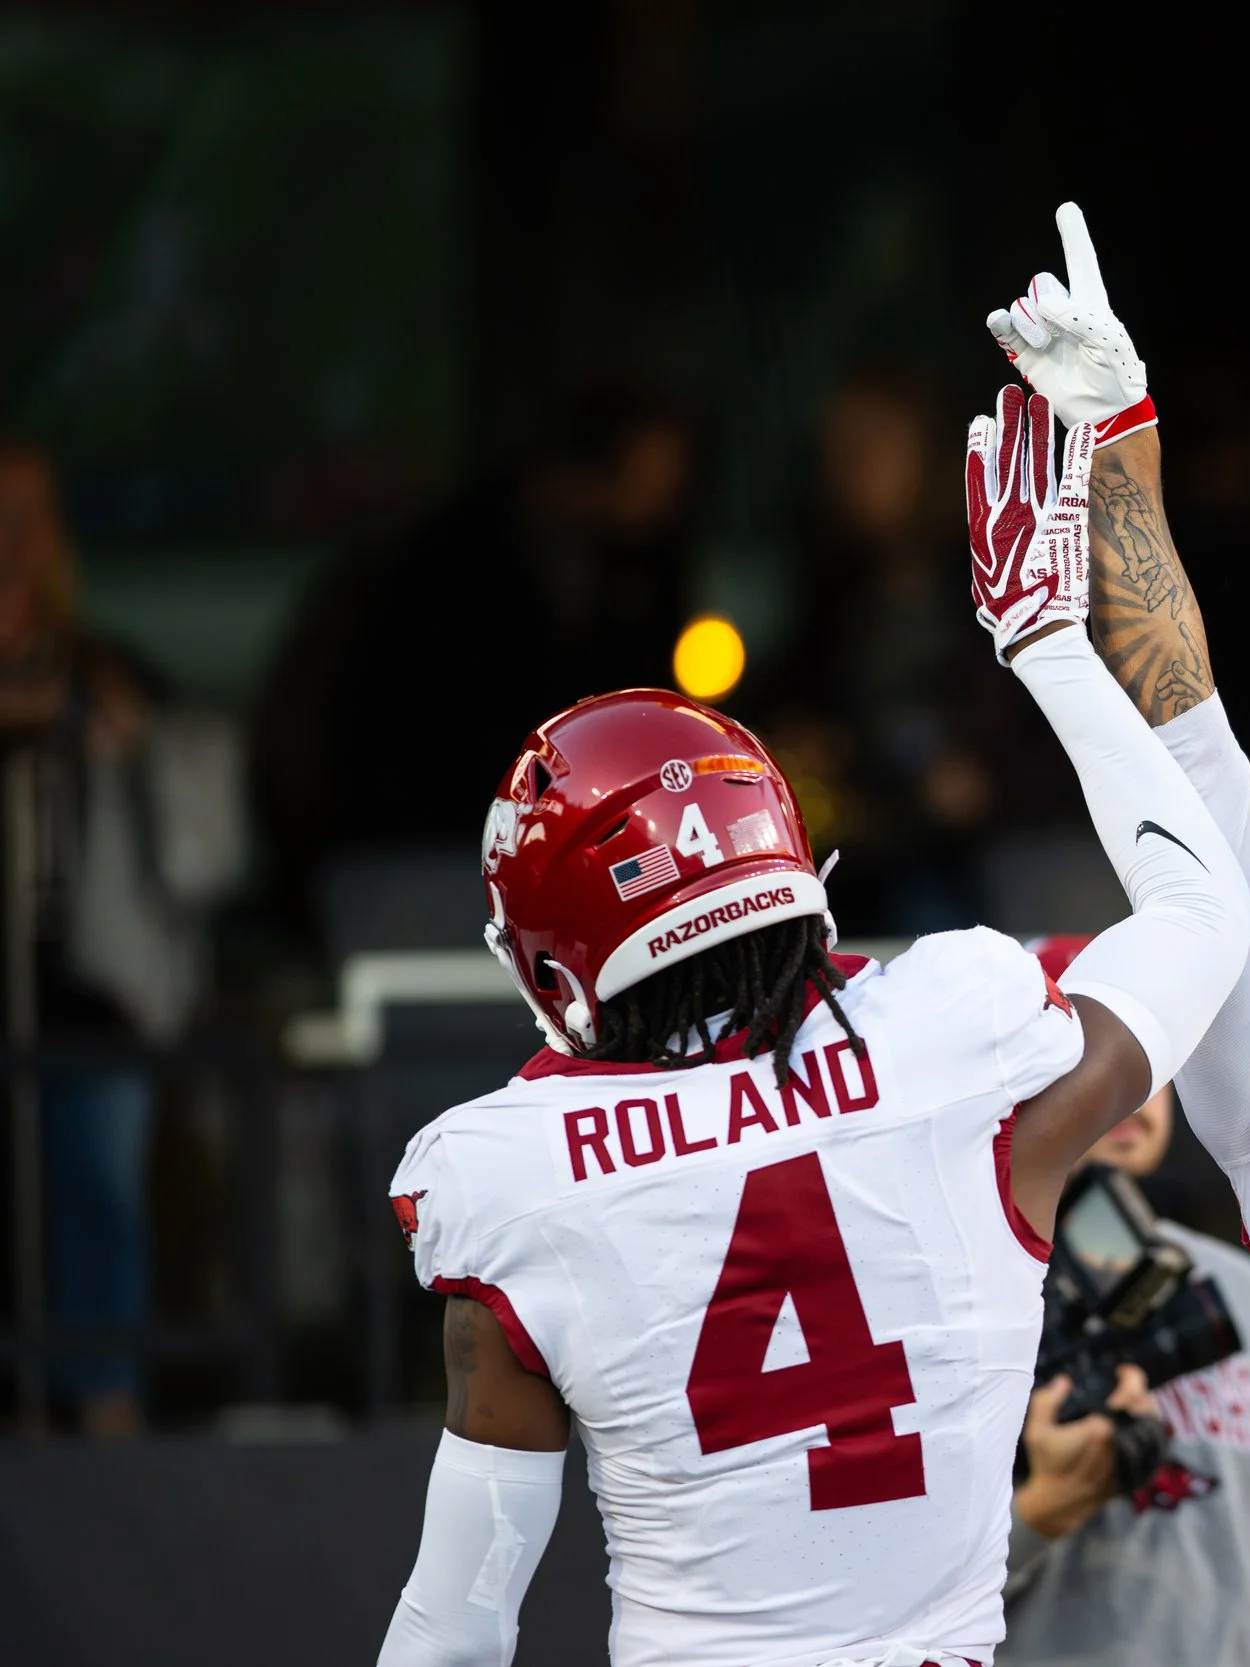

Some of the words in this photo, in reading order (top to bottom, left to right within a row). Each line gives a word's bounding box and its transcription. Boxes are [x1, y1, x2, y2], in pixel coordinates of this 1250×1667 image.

[1062, 537, 1071, 591] RAZORBACKS
[662, 761, 691, 791] SEC
[675, 803, 725, 868] 4
[647, 886, 795, 958] RAZORBACKS
[563, 1035, 880, 1182] ROLAND
[685, 1150, 927, 1511] 4
